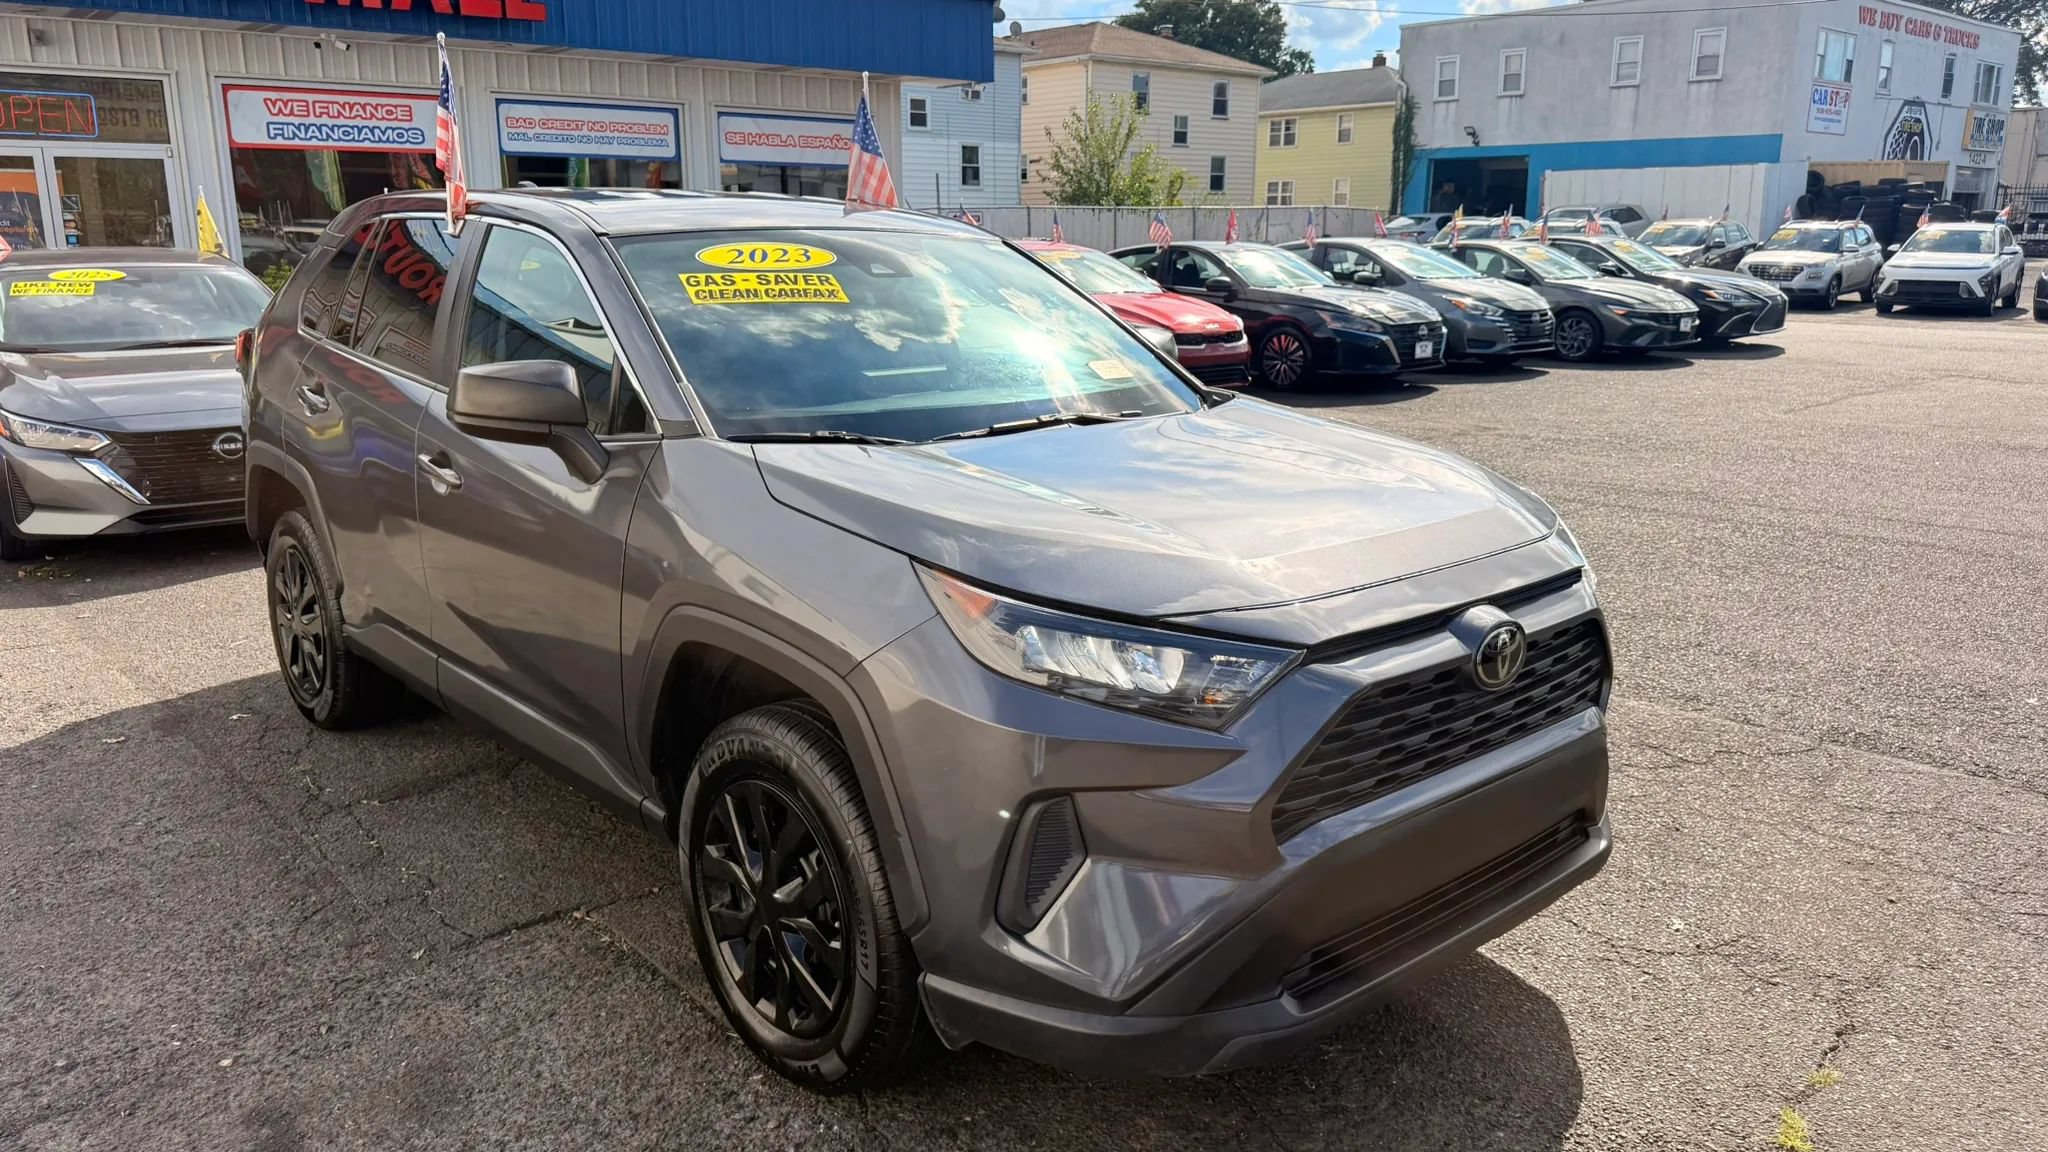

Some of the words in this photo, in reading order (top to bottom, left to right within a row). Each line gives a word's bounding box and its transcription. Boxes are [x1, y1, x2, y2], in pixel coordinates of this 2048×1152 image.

[1859, 5, 1877, 26] WE
[1879, 11, 1904, 32] BUY
[1905, 17, 1932, 38] CARS
[1943, 25, 1980, 49] TRUCKS
[1813, 88, 1828, 106] CAR
[0, 95, 93, 134] PEN
[264, 98, 309, 117] WE
[313, 101, 412, 121] FINANCE
[267, 122, 425, 144] FINANCIAMOS
[506, 117, 536, 129] BAD
[538, 119, 585, 131] CREDIT
[587, 121, 607, 132] NO
[609, 122, 669, 135] PROBLEM
[1971, 117, 1986, 134] TIRE
[1986, 119, 2004, 136] SHOP
[507, 132, 532, 141] MAL
[533, 133, 576, 143] CREDITO
[577, 135, 593, 144] NO
[594, 135, 615, 145] HAY
[617, 137, 669, 147] PROBLEMA
[725, 131, 745, 145] SE
[748, 133, 796, 147] HABLA
[798, 134, 851, 150] ESPAÑO
[726, 248, 812, 264] 2023
[685, 274, 737, 288] GAS
[757, 274, 837, 287] SAVER
[694, 288, 763, 301] CLEAN
[764, 288, 840, 300] CARFAX
[212, 442, 243, 450] NISSA
